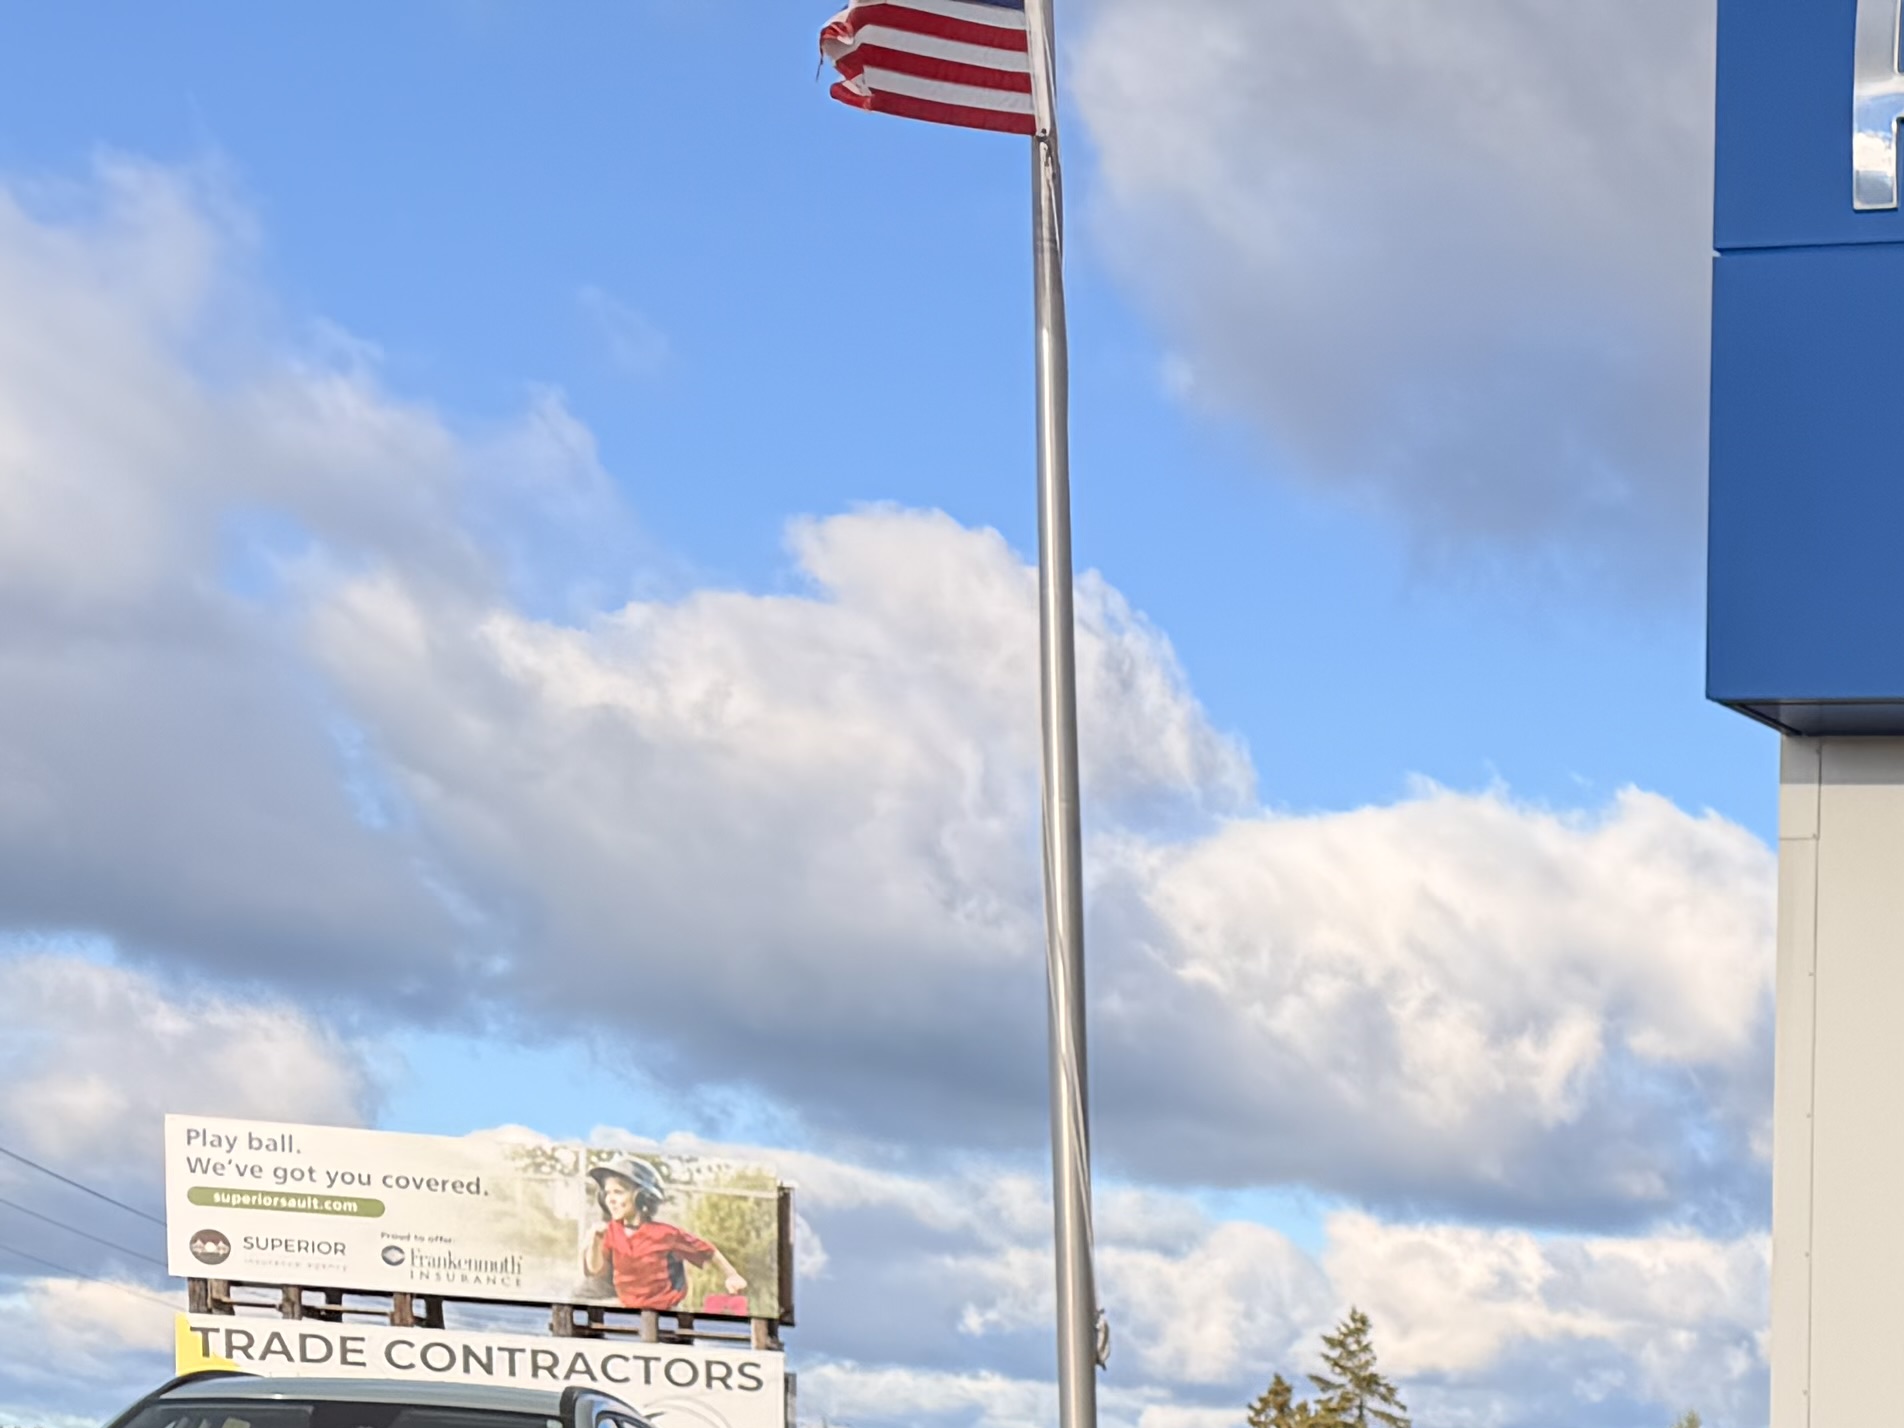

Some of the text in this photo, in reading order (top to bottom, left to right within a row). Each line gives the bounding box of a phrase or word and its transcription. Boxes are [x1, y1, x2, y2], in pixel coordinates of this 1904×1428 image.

[186, 1128, 302, 1154] Play ball.
[186, 1156, 489, 1196] We've got you covered.
[213, 1191, 359, 1213] superiorsault.com
[243, 1236, 346, 1256] SUPERIOR
[410, 1270, 520, 1287] INSURANCE
[189, 1326, 764, 1392] TRADE CONTRACTORS
